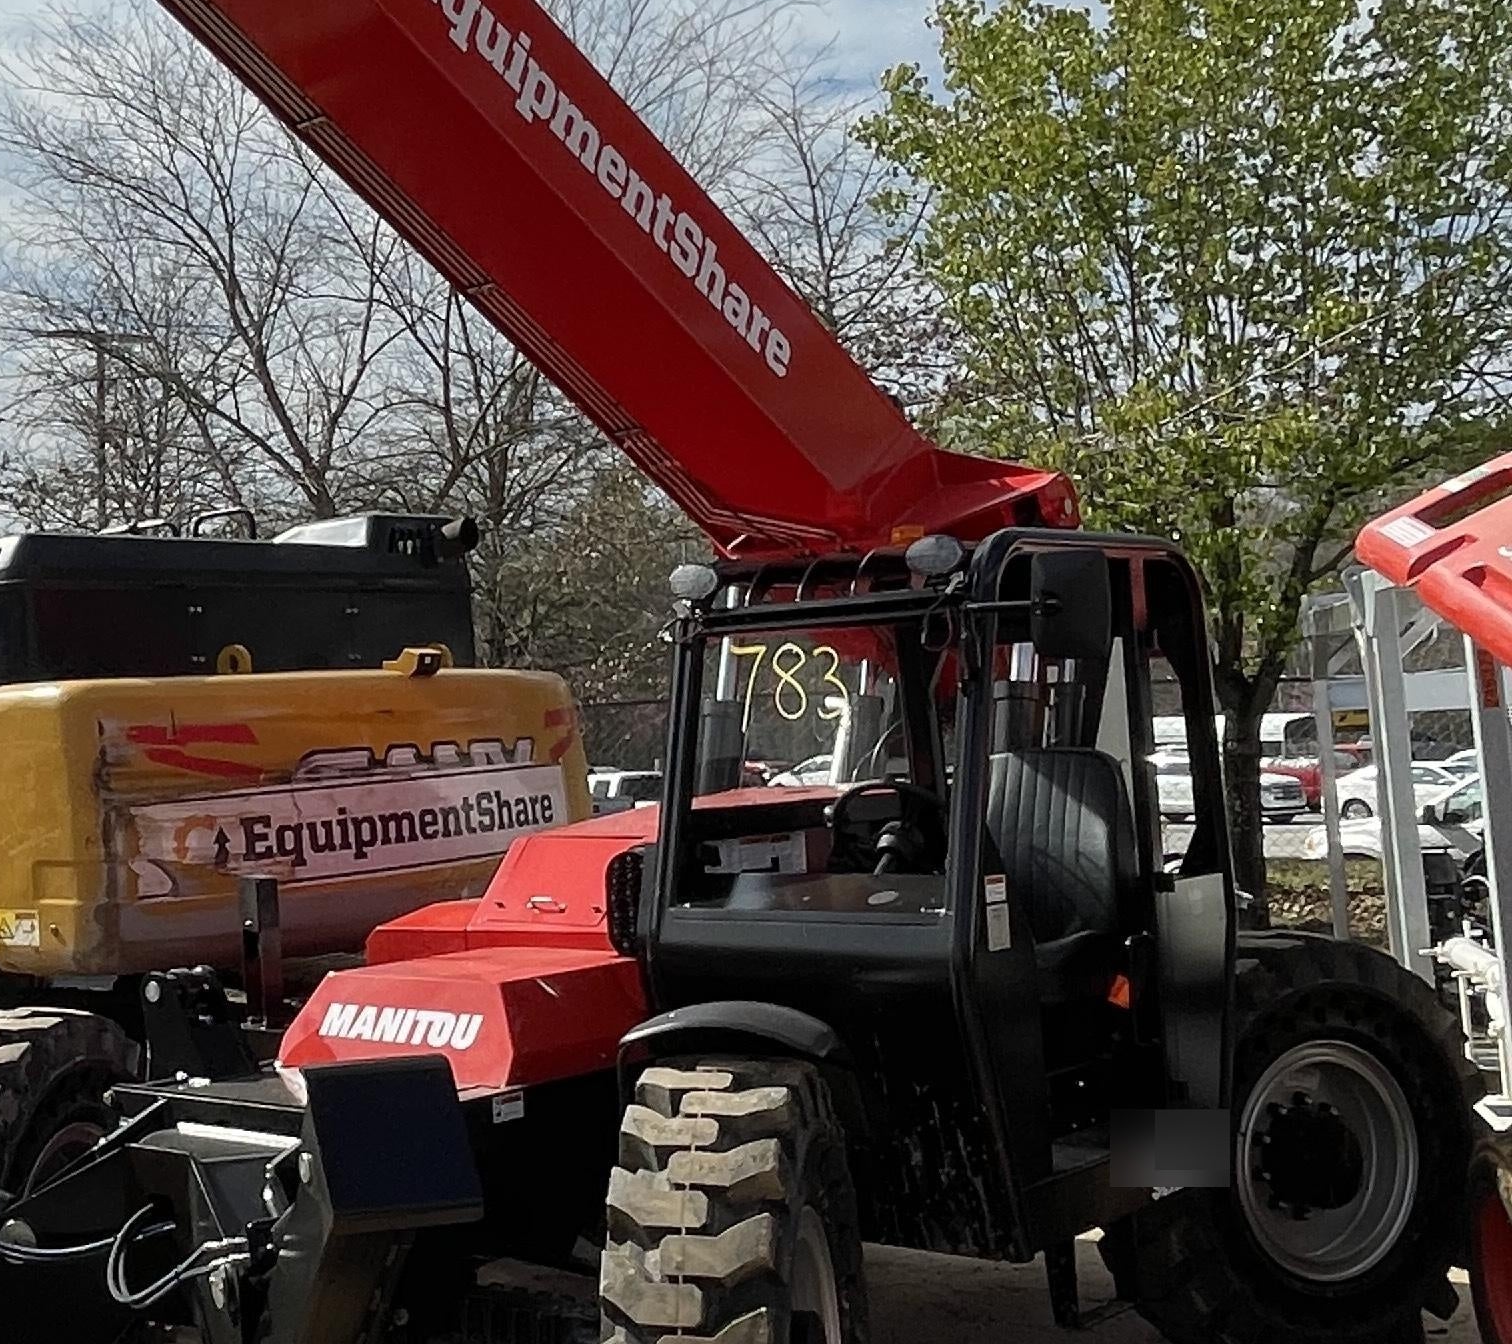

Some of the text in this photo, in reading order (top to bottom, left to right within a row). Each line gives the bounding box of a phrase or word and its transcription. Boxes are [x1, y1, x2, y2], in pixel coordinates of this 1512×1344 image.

[730, 642, 849, 733] 783
[239, 790, 555, 867] EquipmentShare
[318, 1002, 485, 1050] MANITOU
